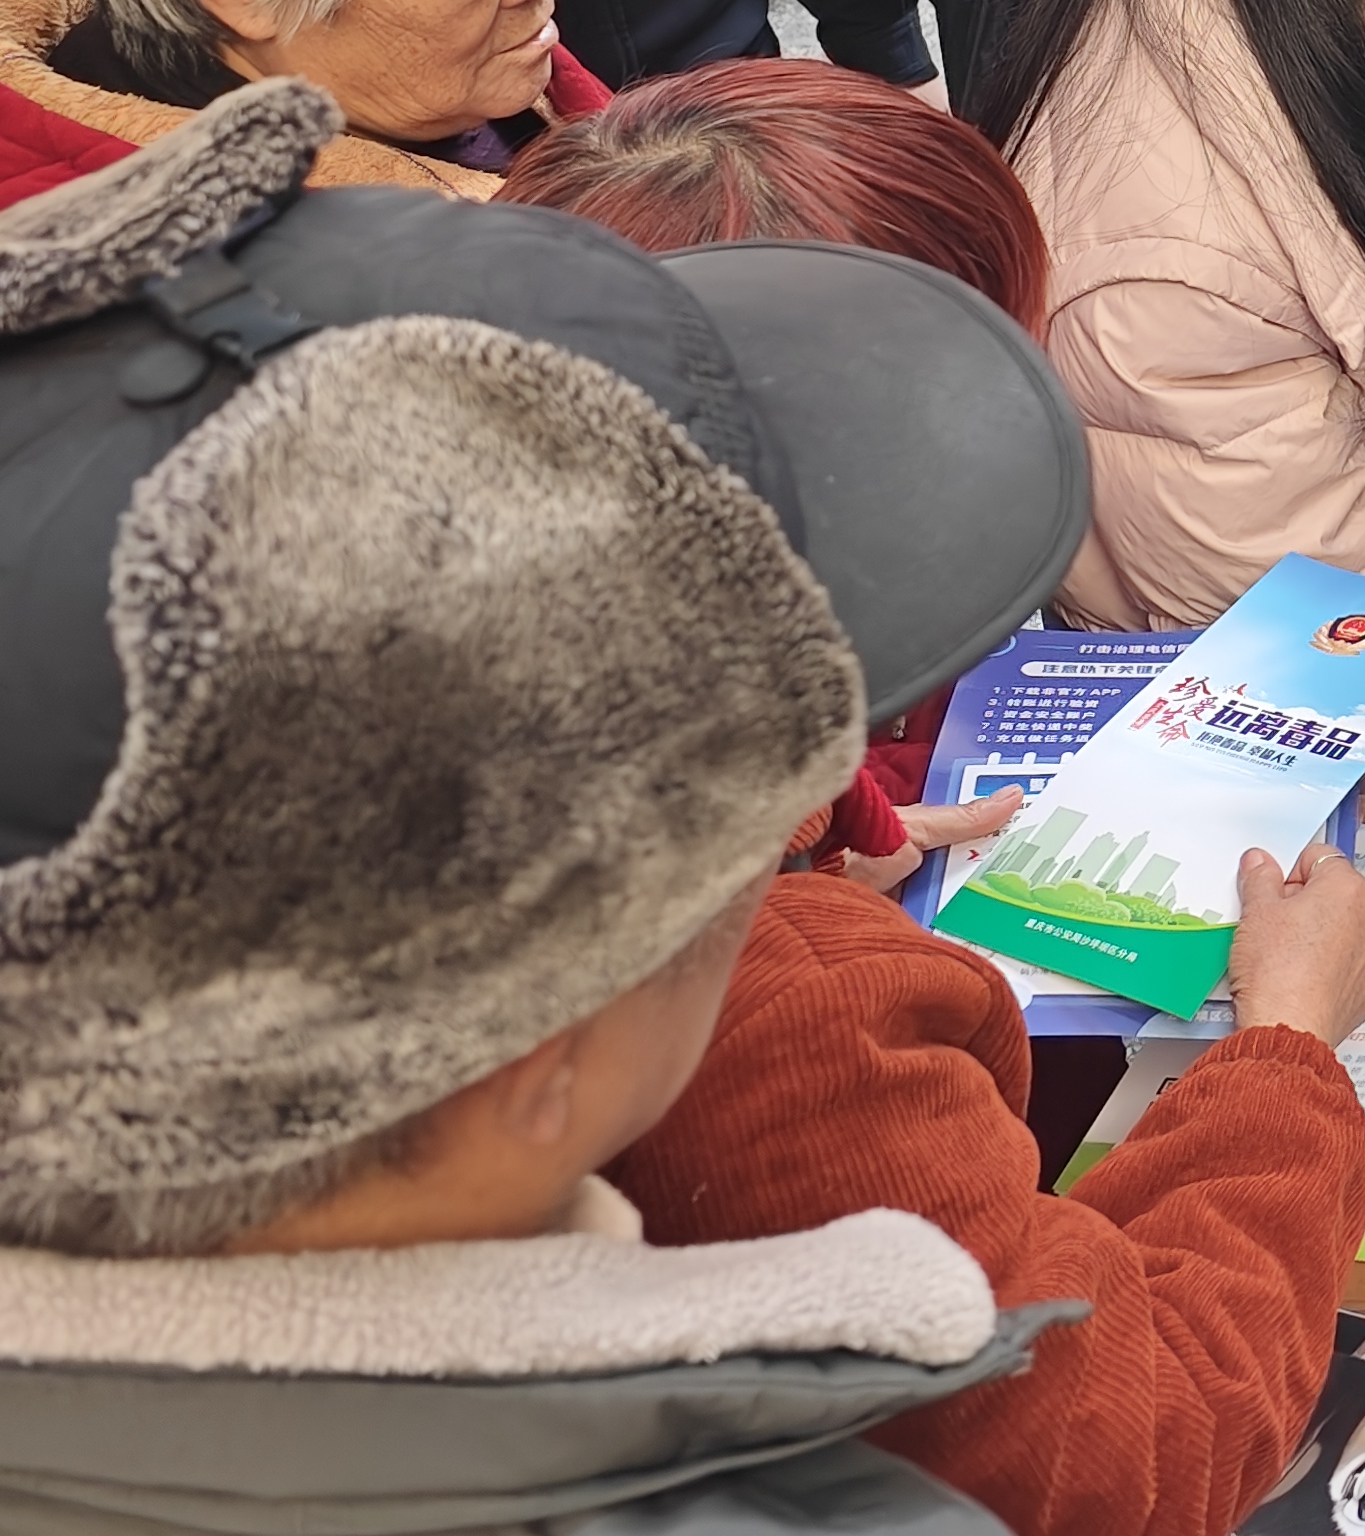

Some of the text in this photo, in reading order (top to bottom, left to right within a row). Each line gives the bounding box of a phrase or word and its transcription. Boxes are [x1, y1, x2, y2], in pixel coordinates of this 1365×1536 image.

[1205, 700, 1361, 761] 远离毒品
[1024, 917, 1140, 963] 重庆市公安局沙坪坝区分局
